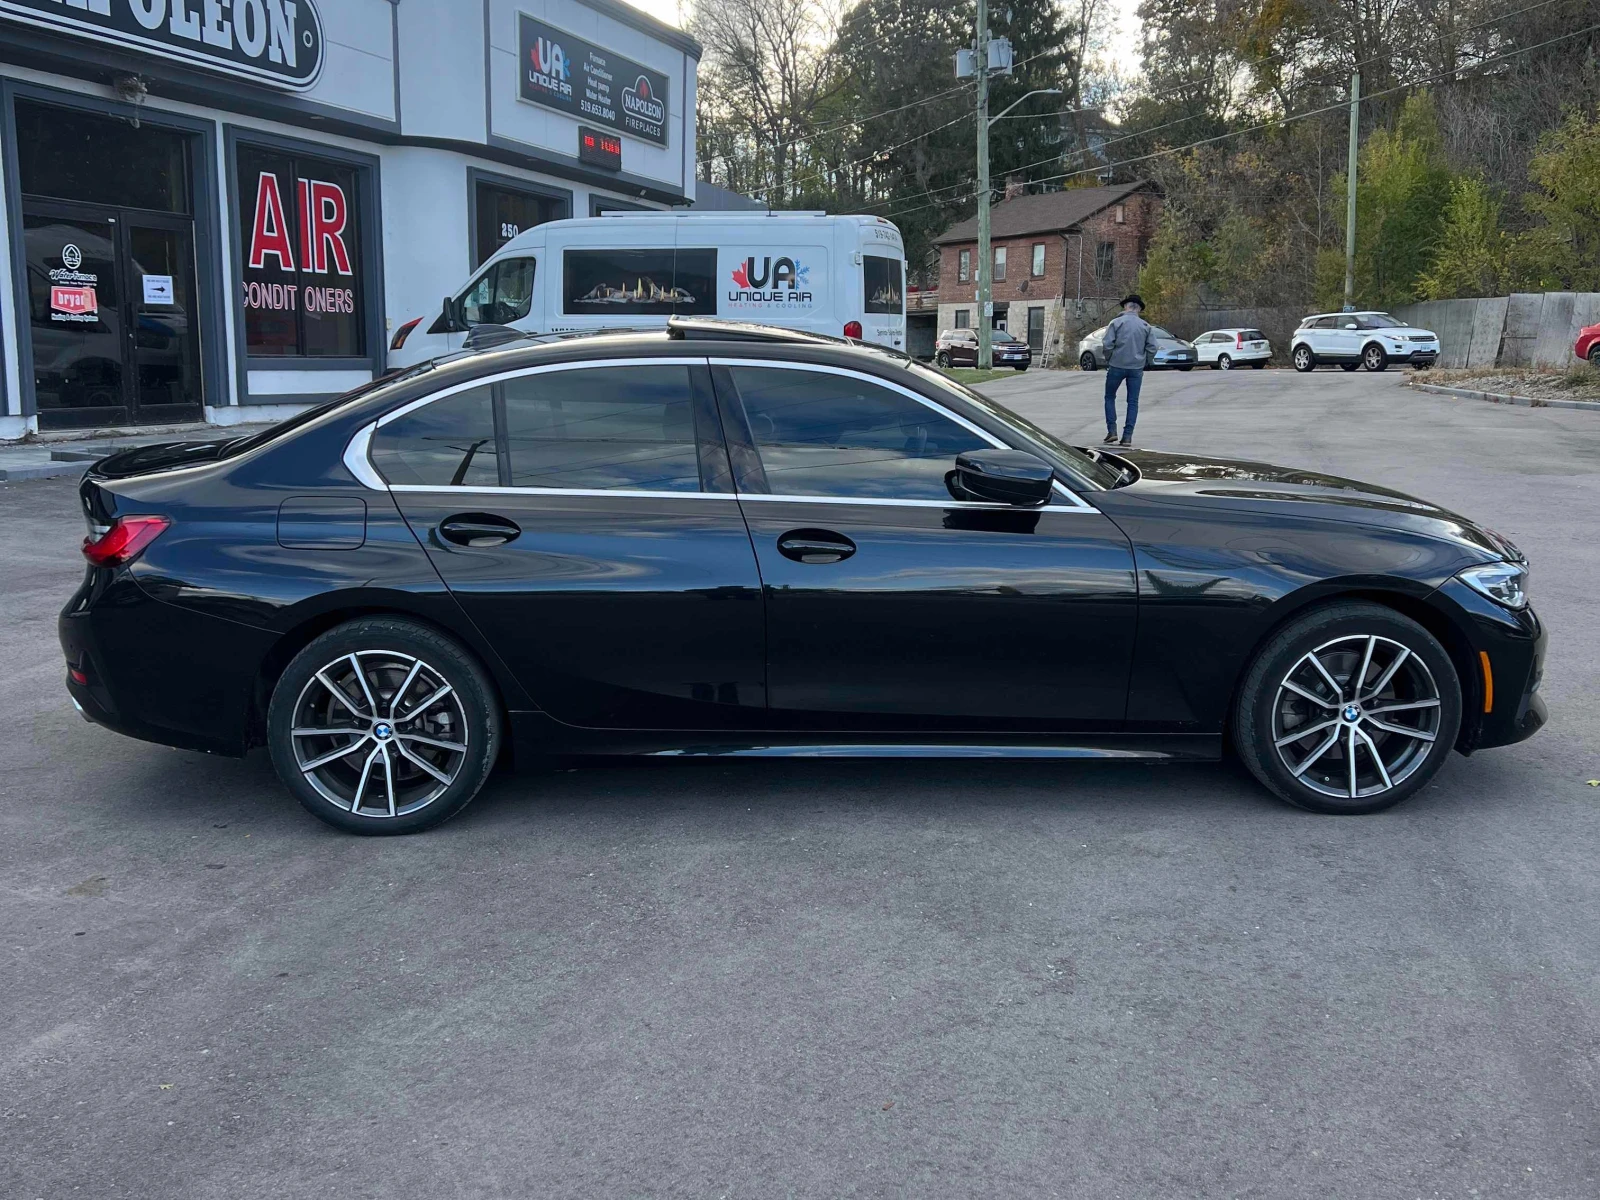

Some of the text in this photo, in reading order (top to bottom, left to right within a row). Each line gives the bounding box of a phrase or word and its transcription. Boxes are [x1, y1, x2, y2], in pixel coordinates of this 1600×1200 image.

[538, 36, 564, 81] UA
[589, 51, 606, 67] Furnace
[528, 69, 572, 96] UNIQUE AIR
[590, 64, 613, 81] Conditioner
[587, 75, 610, 95] Heat pump
[585, 87, 611, 106] Water Heater
[625, 93, 662, 119] NAPOLEON
[580, 99, 616, 121] 519.653.8040
[625, 116, 661, 137] FIREPLACES
[248, 171, 353, 276] AIR
[501, 222, 519, 238] 250
[747, 256, 796, 290] UA
[242, 281, 354, 313] CONDITONERS
[728, 291, 813, 303] UNIQUE AIR
